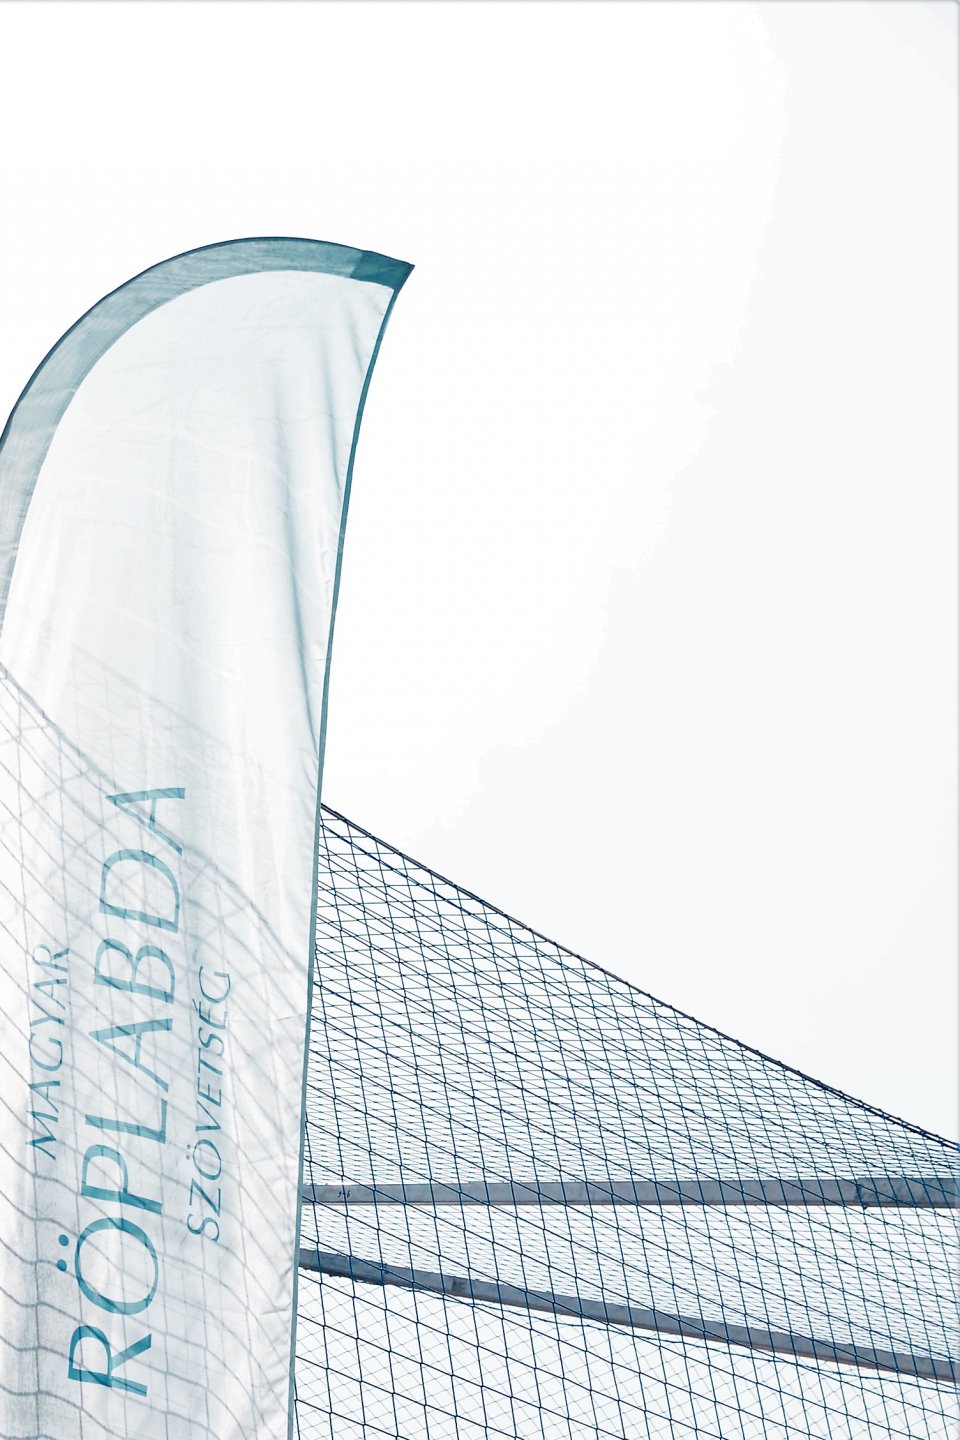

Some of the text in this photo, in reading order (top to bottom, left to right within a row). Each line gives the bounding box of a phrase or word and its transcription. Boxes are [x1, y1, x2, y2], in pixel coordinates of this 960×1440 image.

[26, 943, 69, 1160] MAGYAR
[58, 787, 185, 1397] RÖPLABDA
[186, 966, 232, 1242] SZÖVETSÉG
